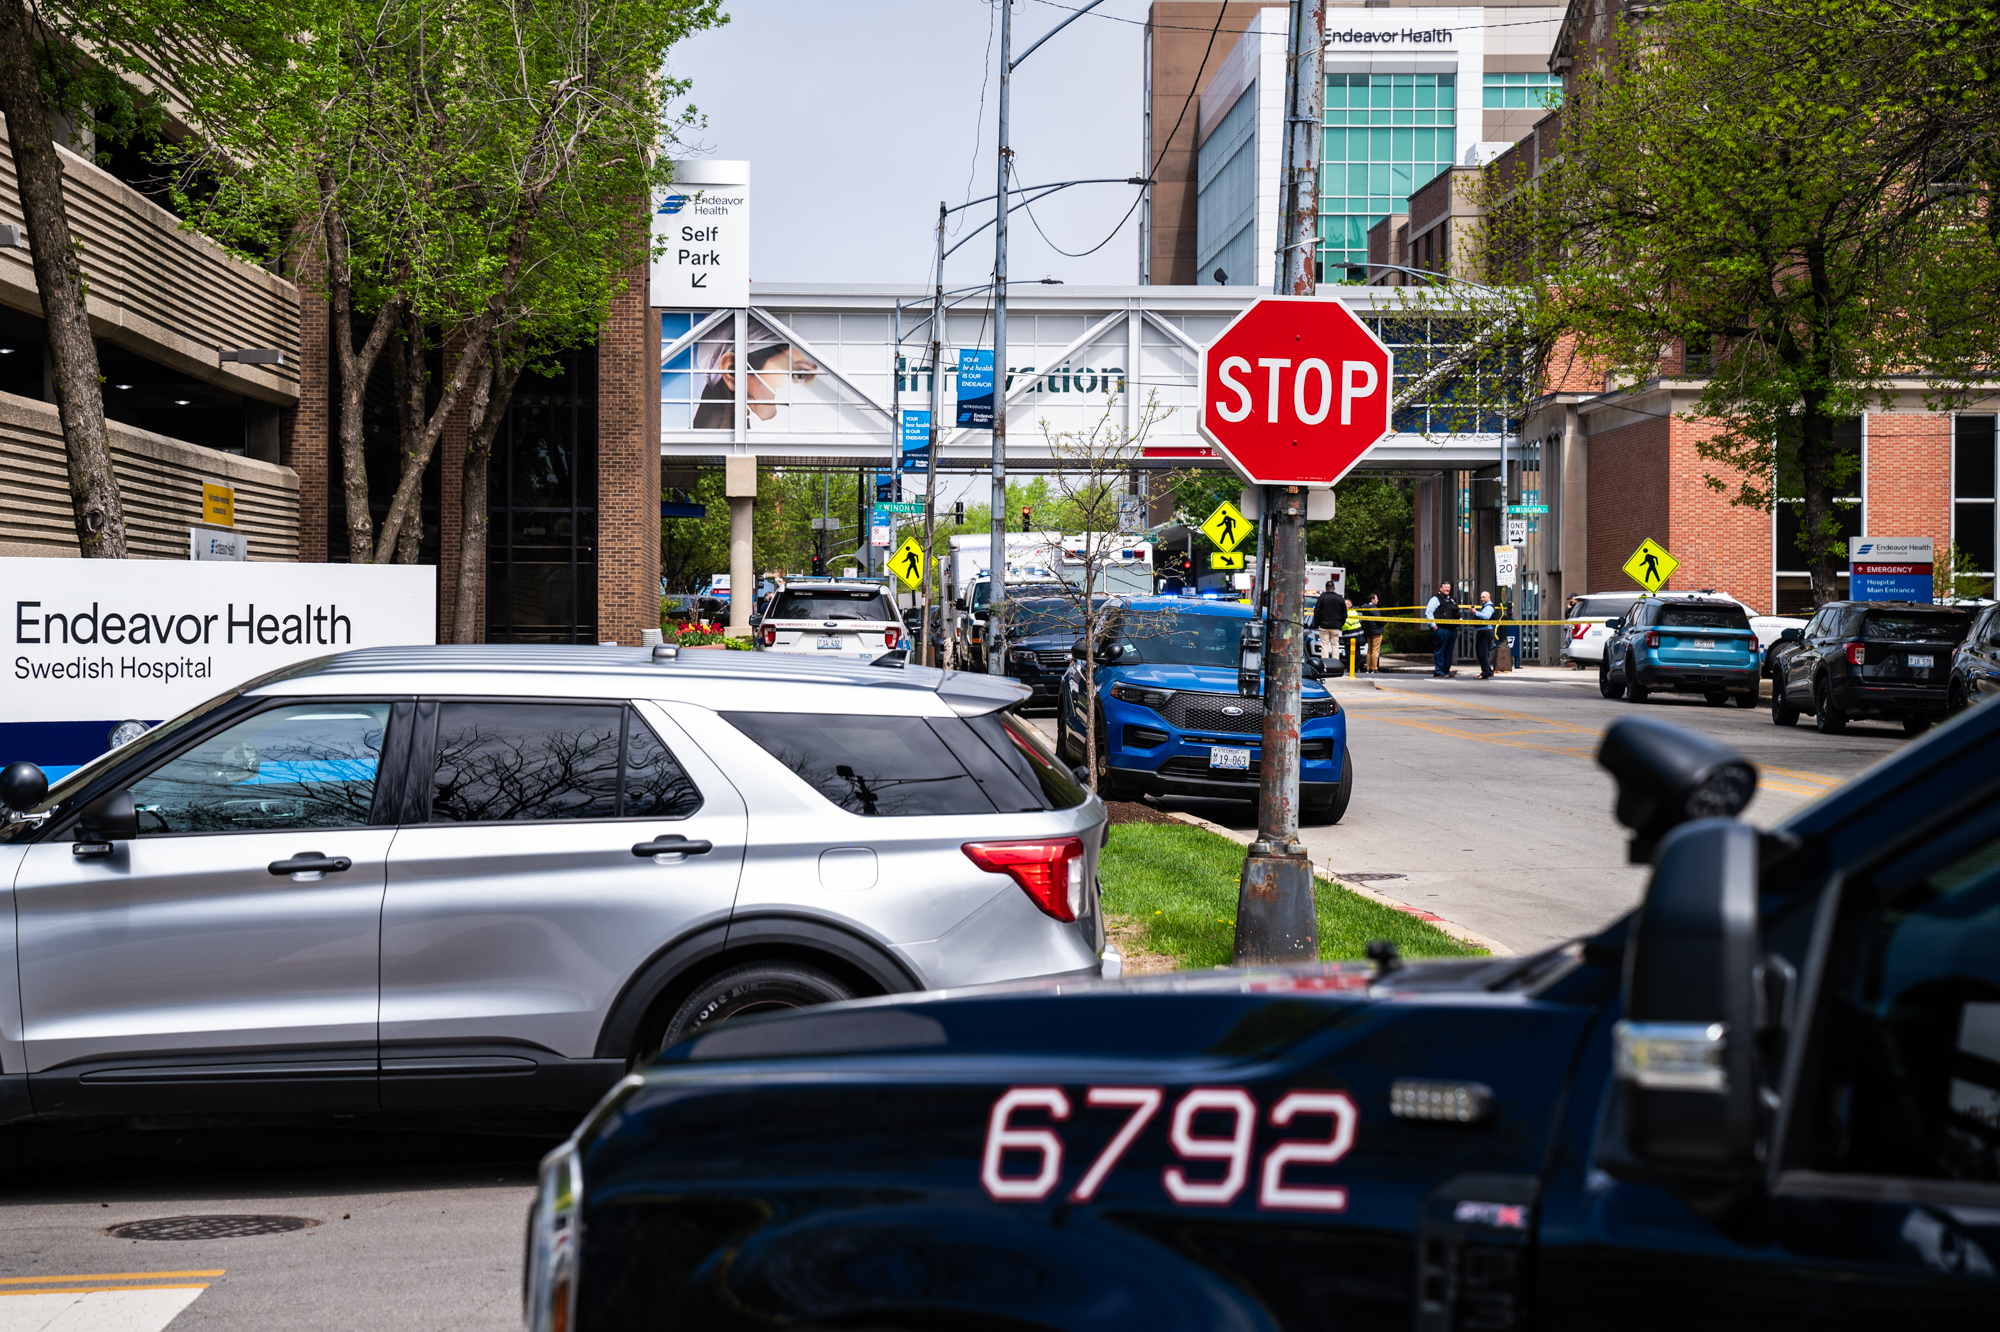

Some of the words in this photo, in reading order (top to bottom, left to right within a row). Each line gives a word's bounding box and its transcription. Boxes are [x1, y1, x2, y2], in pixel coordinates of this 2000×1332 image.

[1325, 28, 1398, 43] Endeavor
[1401, 28, 1452, 43] Health
[695, 196, 744, 205] Endeavor
[694, 206, 728, 215] Health
[681, 226, 718, 241] Self
[678, 249, 720, 265] Park
[1215, 355, 1378, 425] STOP
[884, 504, 916, 512] WINONA
[1499, 564, 1512, 573] 20
[16, 601, 218, 644] Endeavor
[228, 603, 351, 644] Health
[14, 656, 114, 678] Swedish
[120, 657, 211, 683] Hospital
[1219, 754, 1229, 765] 19
[978, 1084, 1360, 1214] 6792
